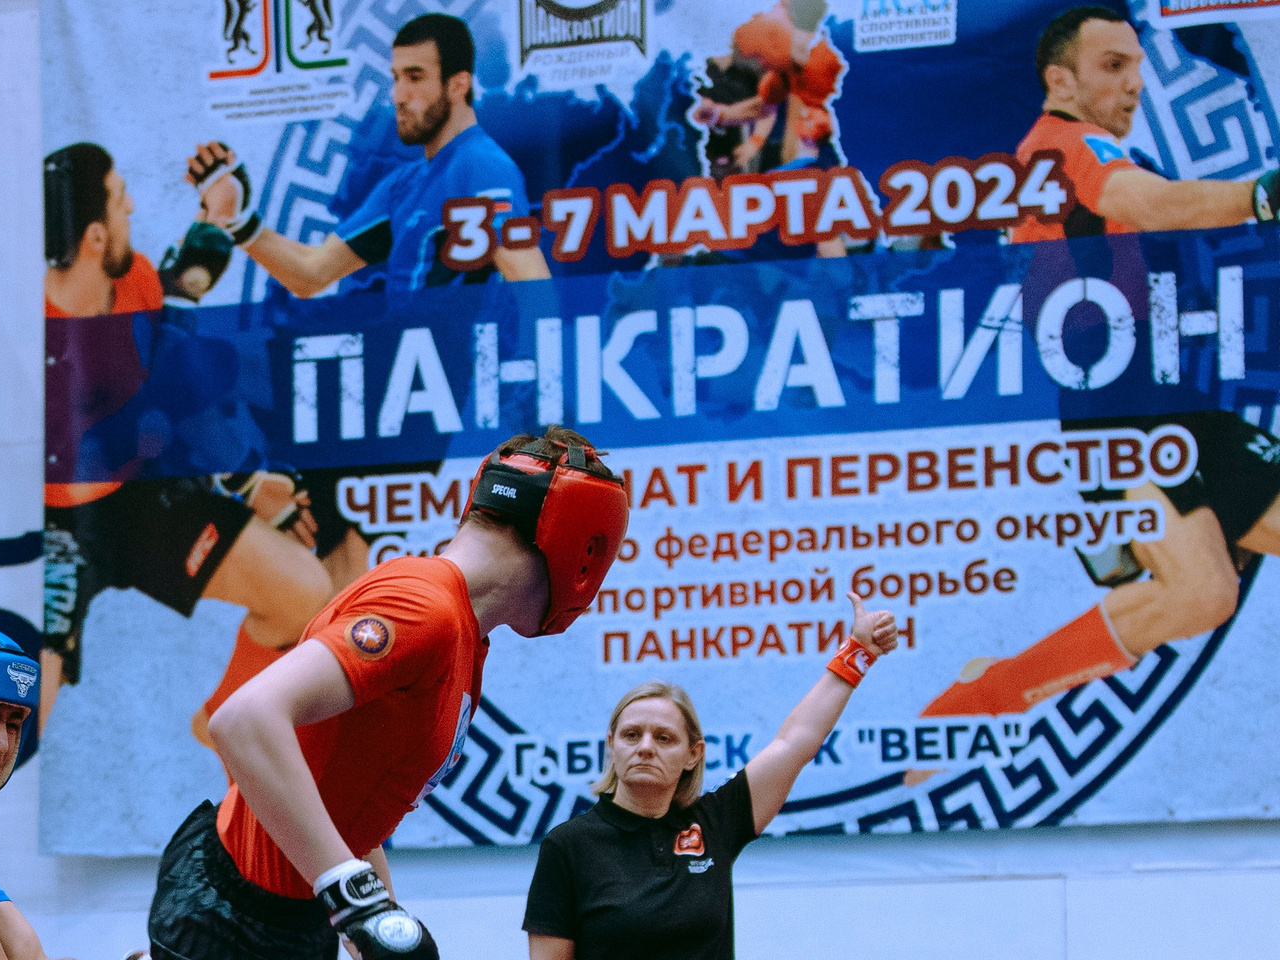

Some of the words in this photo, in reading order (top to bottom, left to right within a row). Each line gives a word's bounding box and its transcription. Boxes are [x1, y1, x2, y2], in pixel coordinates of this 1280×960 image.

[447, 206, 490, 261] 3
[552, 197, 593, 254] 7
[613, 177, 872, 247] МАРТА
[887, 160, 1067, 228] 2024
[292, 266, 1245, 443] ПАНКРАТИОН
[345, 463, 707, 524] ЧЕМАТ
[727, 460, 763, 503] И
[787, 434, 1190, 499] ПЕРВЕНСТВО
[491, 483, 517, 499] SPECIAL
[655, 513, 980, 569] федерального
[996, 508, 1159, 547] округа
[585, 566, 835, 620] портивной
[851, 559, 1018, 606] борьбе
[602, 616, 916, 663] ПАНКРАТИН
[858, 722, 1022, 765] "ВЕГА"
